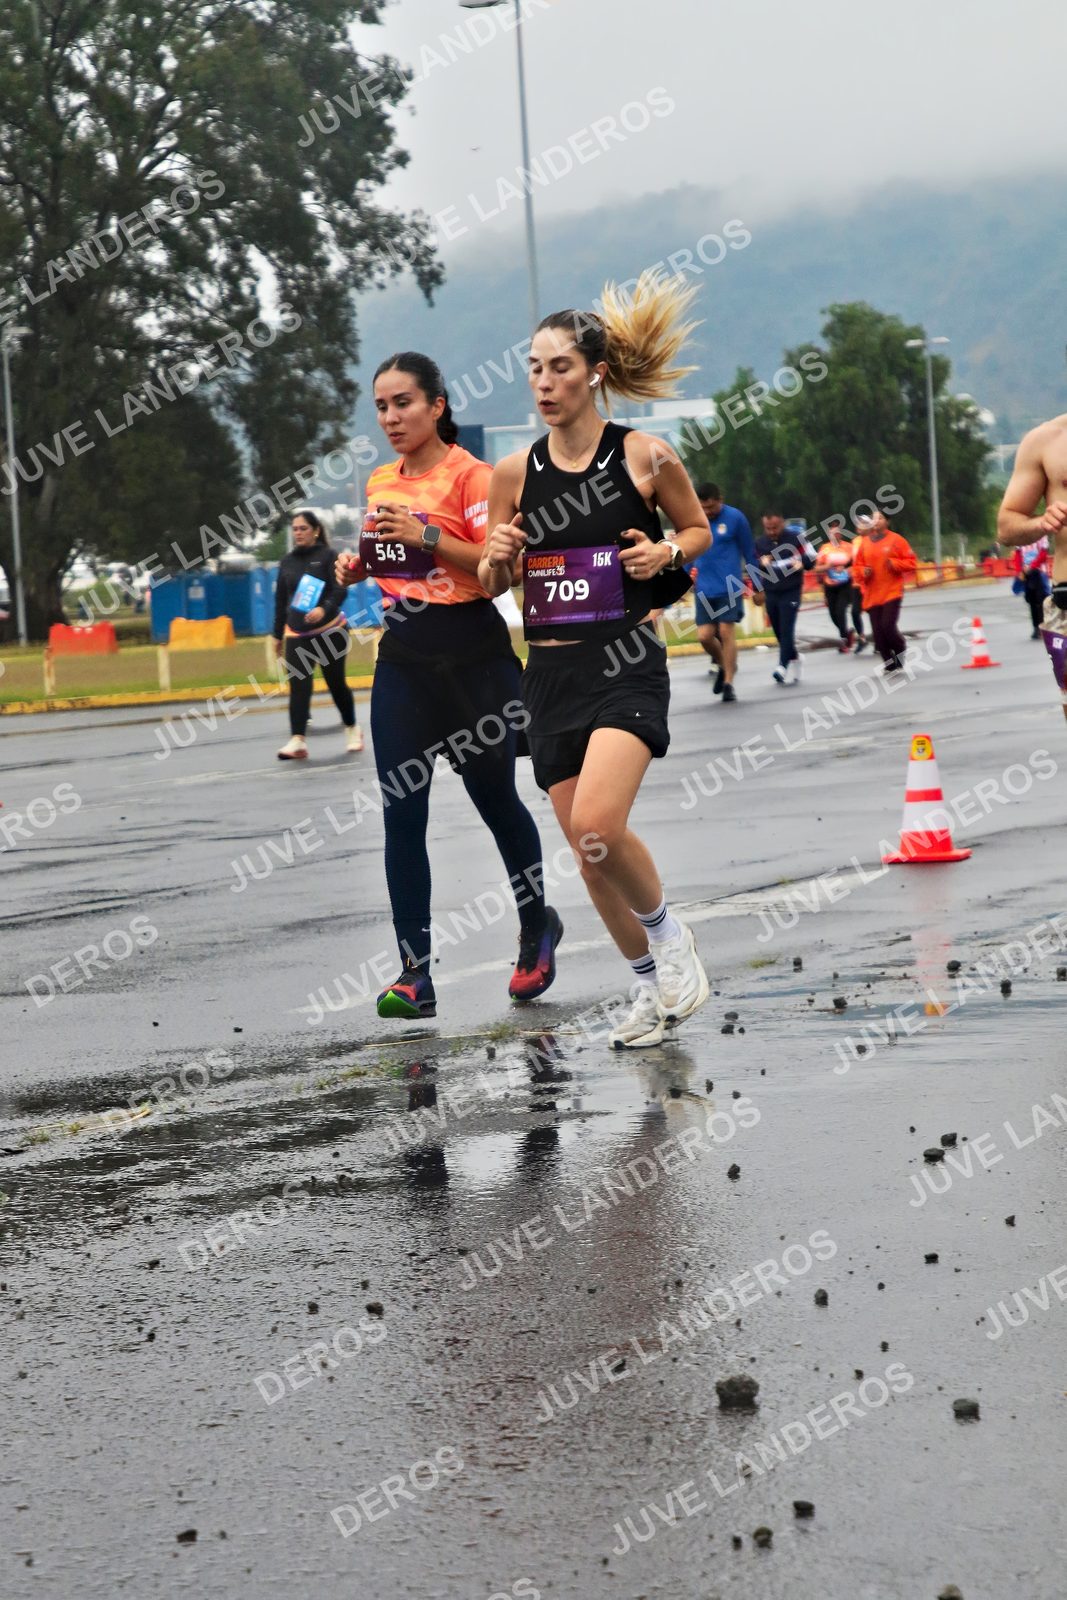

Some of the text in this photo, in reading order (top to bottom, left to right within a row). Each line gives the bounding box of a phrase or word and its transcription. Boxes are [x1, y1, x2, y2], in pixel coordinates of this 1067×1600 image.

[375, 543, 407, 562] 543
[592, 551, 612, 567] 15K
[527, 555, 565, 569] CARRERA
[527, 567, 557, 577] OMNILIFE
[544, 579, 590, 602] 709
